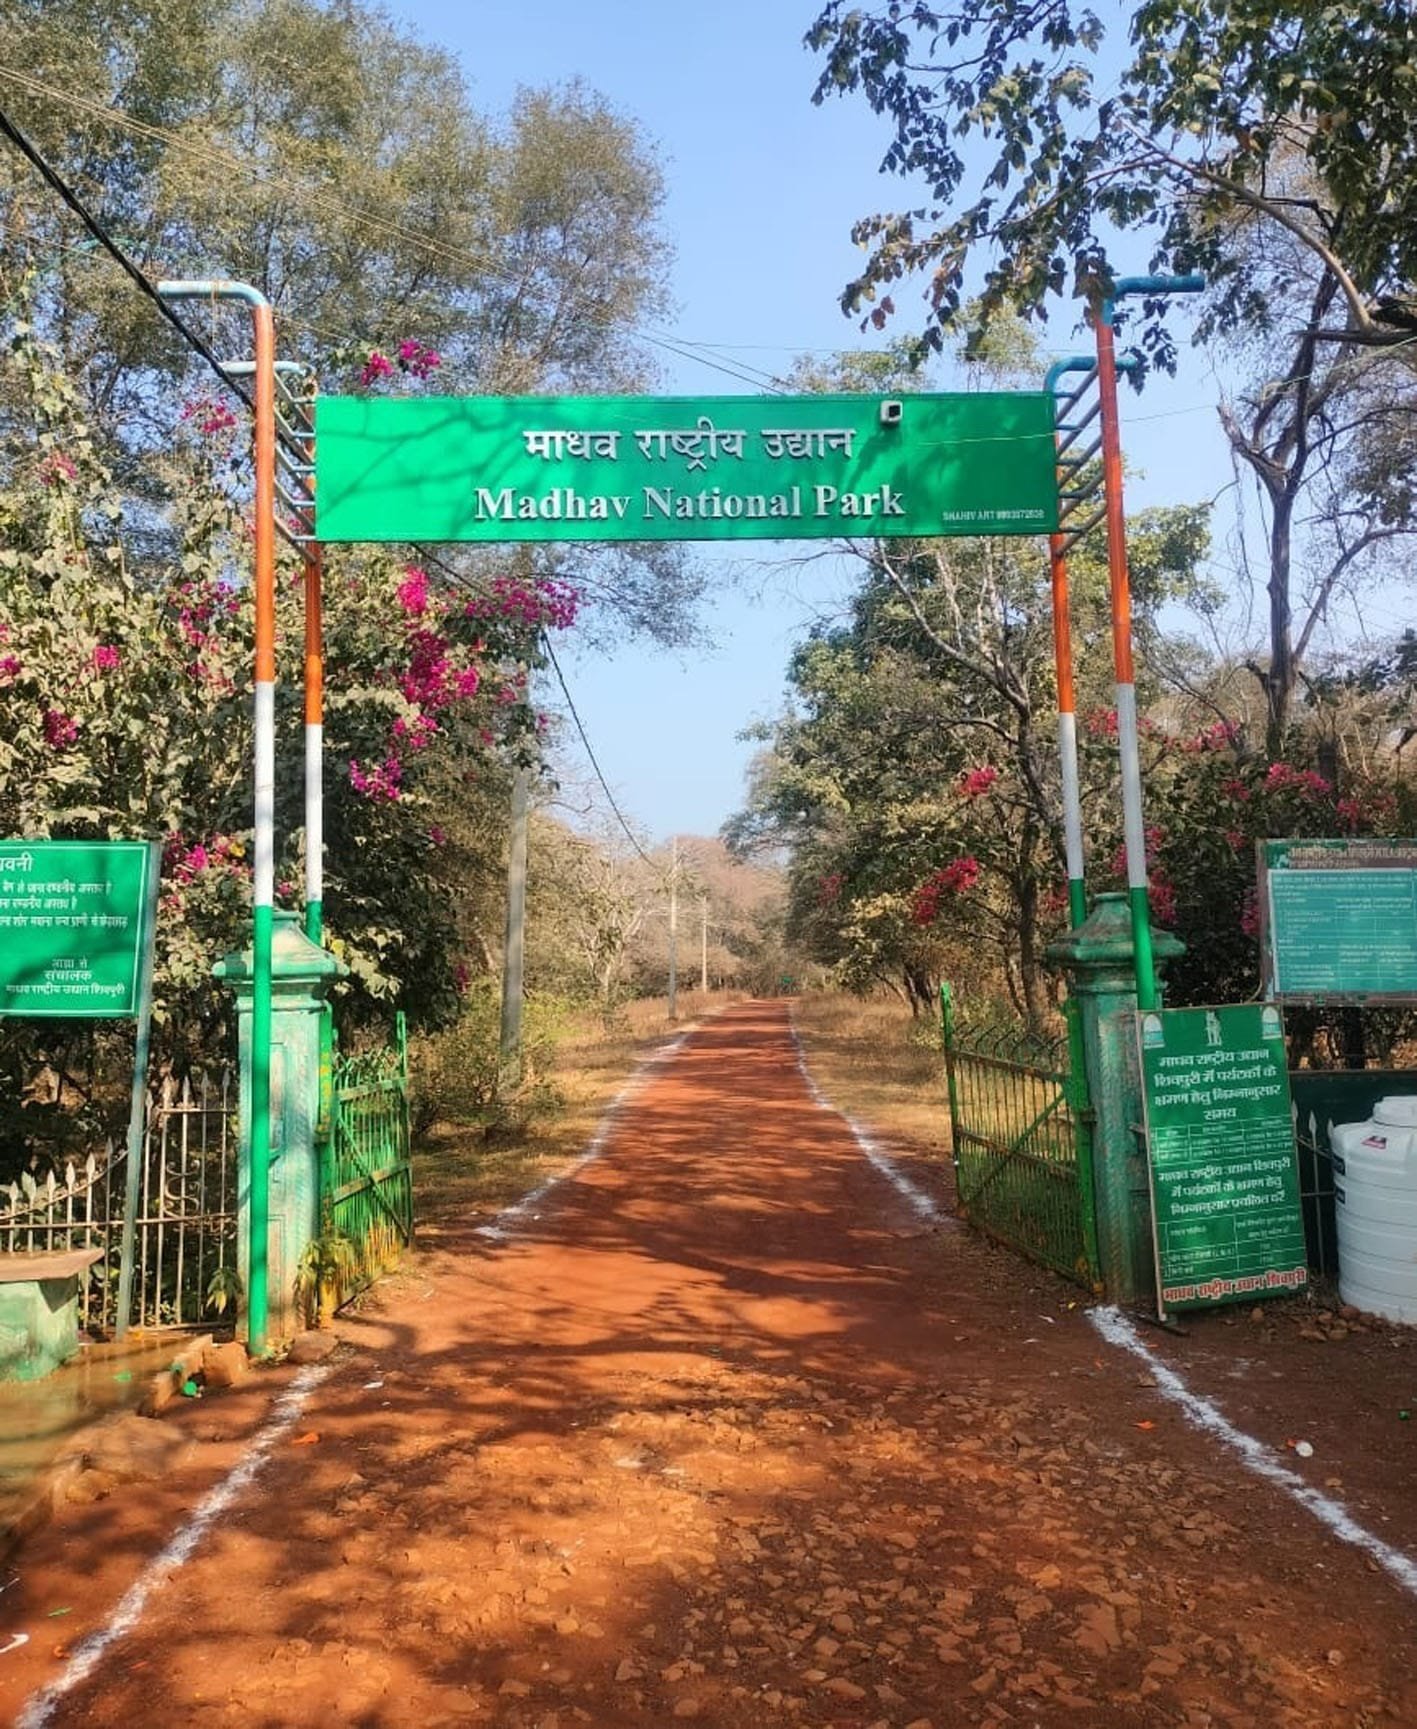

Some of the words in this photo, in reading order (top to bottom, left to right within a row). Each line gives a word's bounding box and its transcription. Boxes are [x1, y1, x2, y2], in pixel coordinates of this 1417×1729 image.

[523, 429, 622, 460] माधव
[633, 416, 748, 472] राष्ट्रीय
[760, 427, 857, 459] उद्यान
[474, 487, 631, 521] Madhav
[642, 486, 802, 520] National
[814, 484, 907, 517] Park
